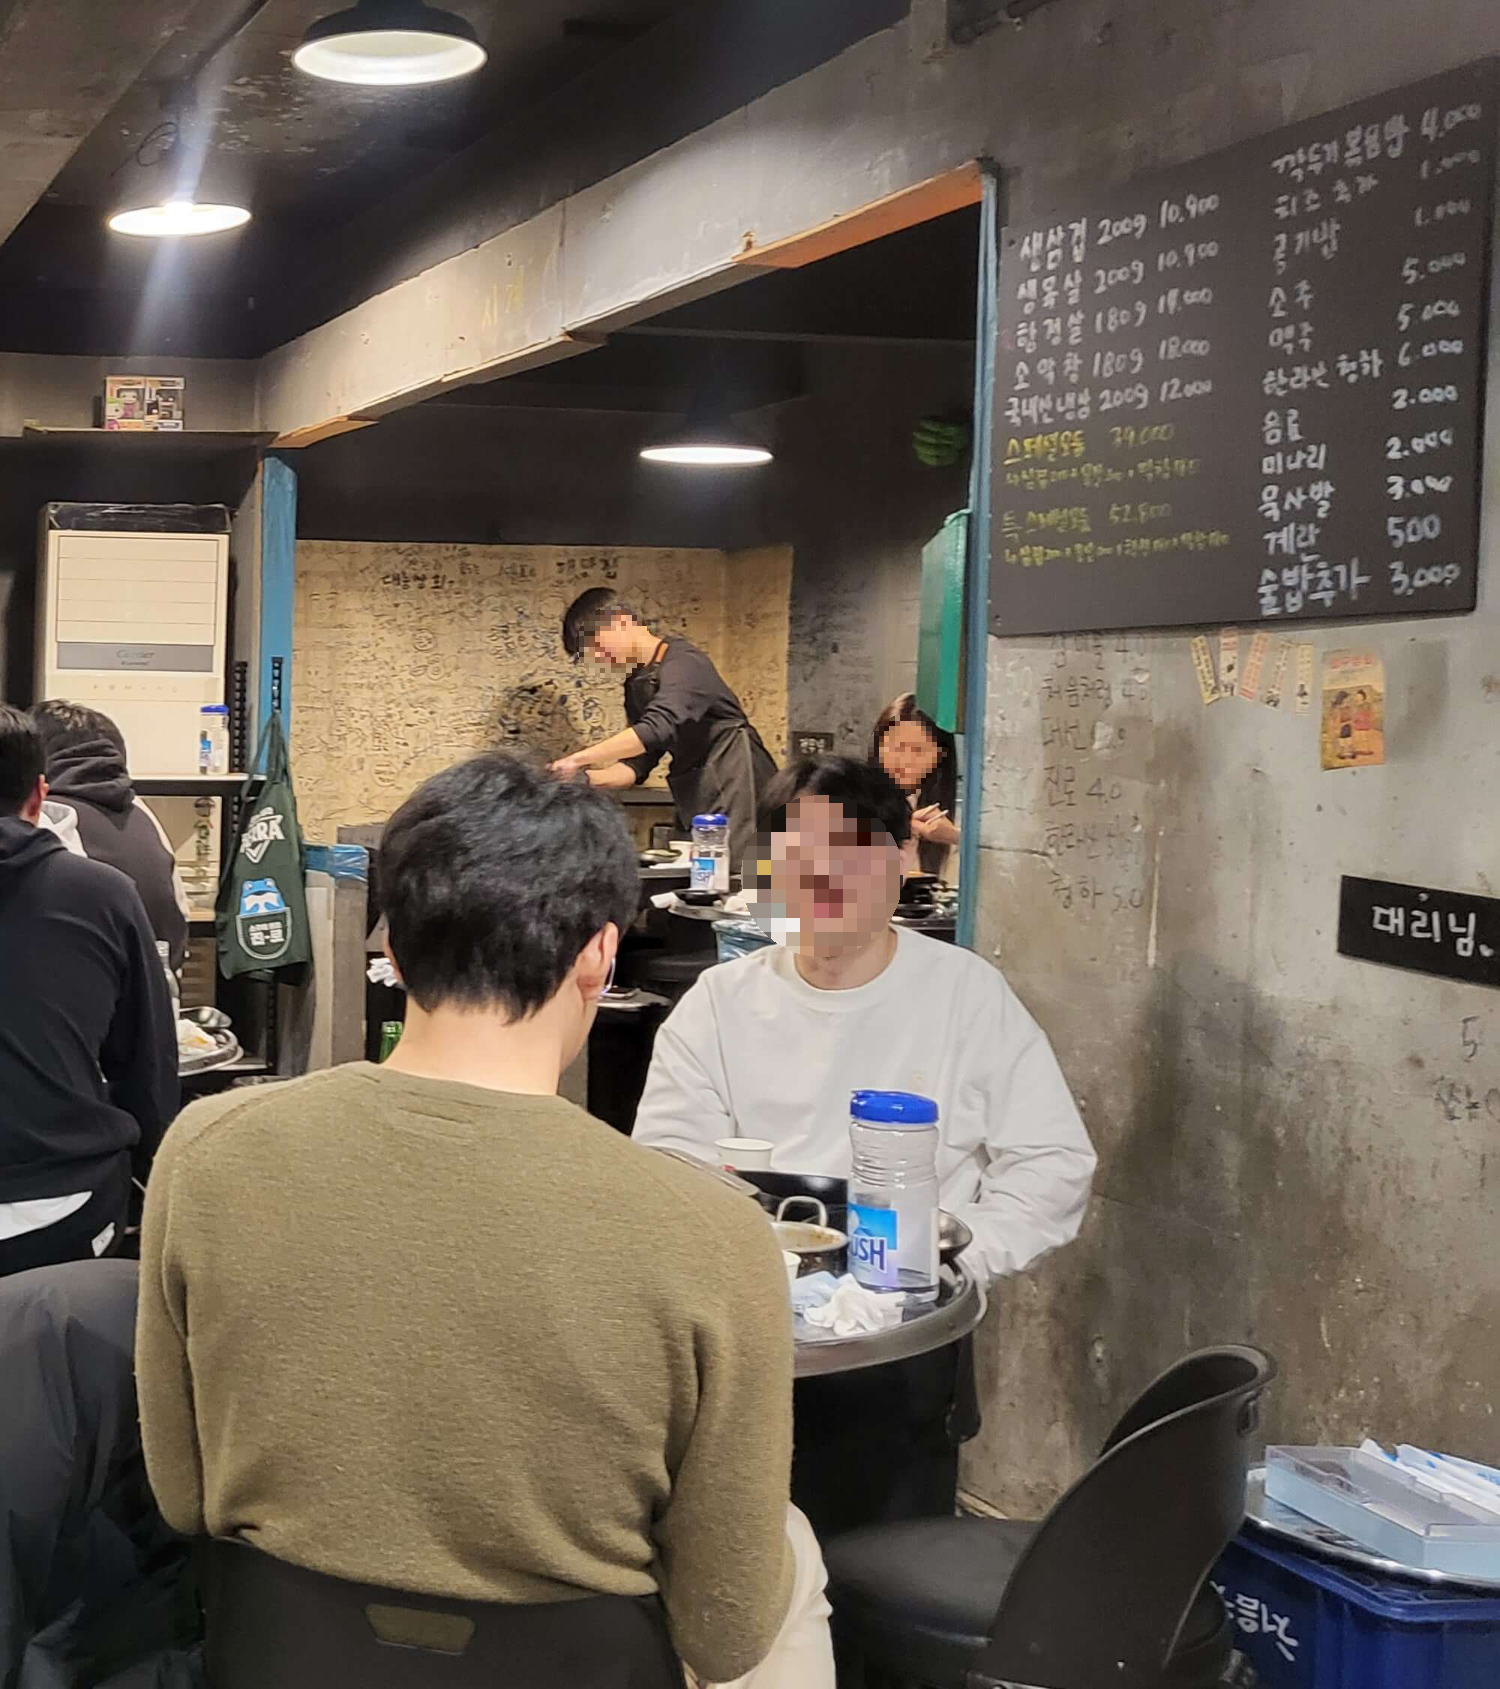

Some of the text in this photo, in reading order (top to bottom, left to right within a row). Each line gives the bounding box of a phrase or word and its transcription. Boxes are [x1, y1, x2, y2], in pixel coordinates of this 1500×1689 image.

[1019, 217, 1088, 272] 생삼겹
[1268, 279, 1315, 318] 소주
[1262, 360, 1331, 397] 한라산
[1261, 407, 1304, 446] 음료
[1261, 443, 1327, 475] 미나리
[1258, 479, 1336, 522] 묵사발
[1262, 520, 1321, 563] 계란
[1386, 512, 1443, 549] 500
[1371, 905, 1477, 958] 대리님
